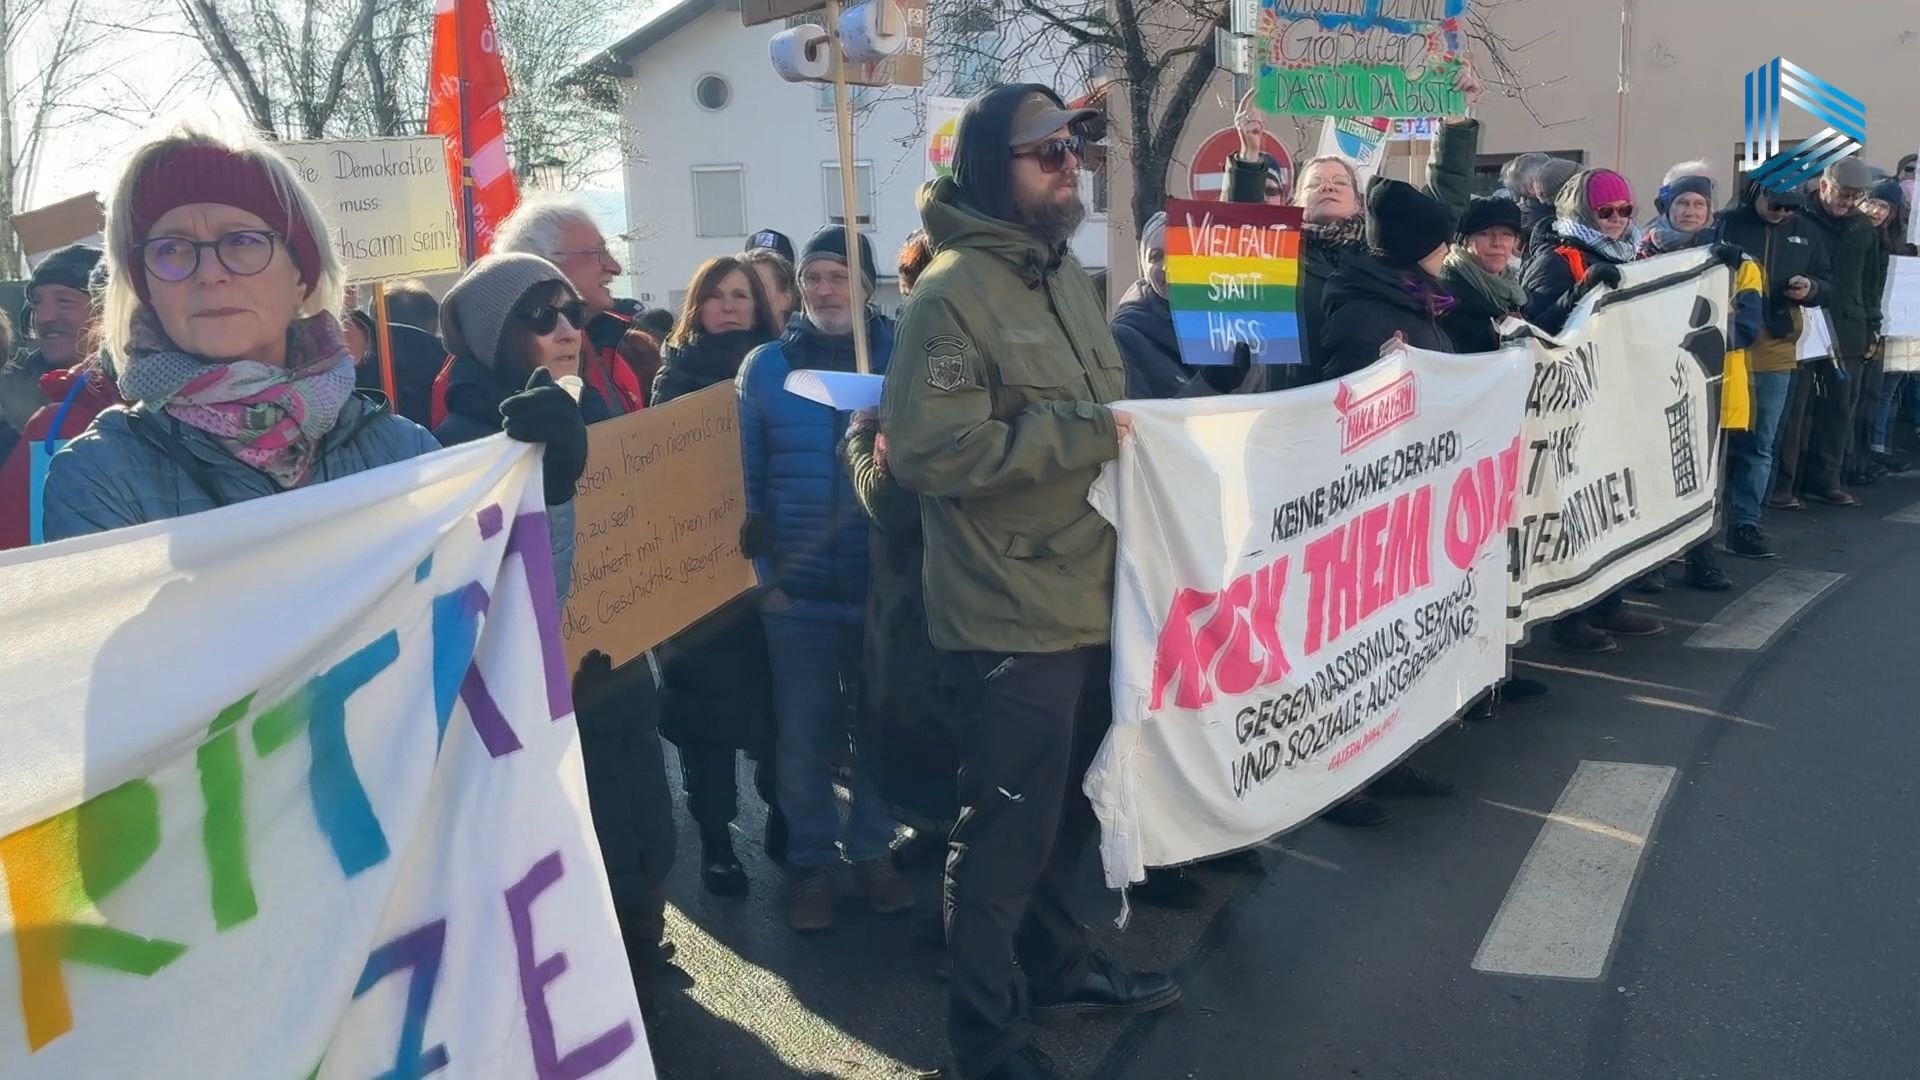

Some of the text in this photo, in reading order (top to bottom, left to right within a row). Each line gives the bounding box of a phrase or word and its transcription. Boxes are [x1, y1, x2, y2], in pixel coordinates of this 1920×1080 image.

[1276, 74, 1328, 110] DASS
[1336, 74, 1361, 111] DU
[1371, 74, 1401, 112] DA
[1393, 117, 1436, 134] ETZT
[331, 144, 435, 180] Demokratie
[339, 196, 380, 213] muss
[335, 211, 453, 260] hsam sein!
[1186, 211, 1288, 259] VIELFALT
[1208, 272, 1265, 302] STATT
[1208, 311, 1264, 355] HASS
[621, 432, 661, 474] hören
[666, 407, 712, 457] niemals
[1271, 430, 1457, 543] KEINE BÜHNE DER AFD
[588, 519, 608, 539] zu
[611, 492, 637, 528] sein
[637, 521, 664, 563] mit
[668, 514, 703, 544] ihnen
[1303, 484, 1434, 658] THEM
[562, 604, 593, 641] die
[597, 559, 673, 625] Geschichte
[1236, 677, 1317, 745] GEGEN
[1232, 741, 1281, 798] UND
[1284, 690, 1363, 767] SOZIALE
